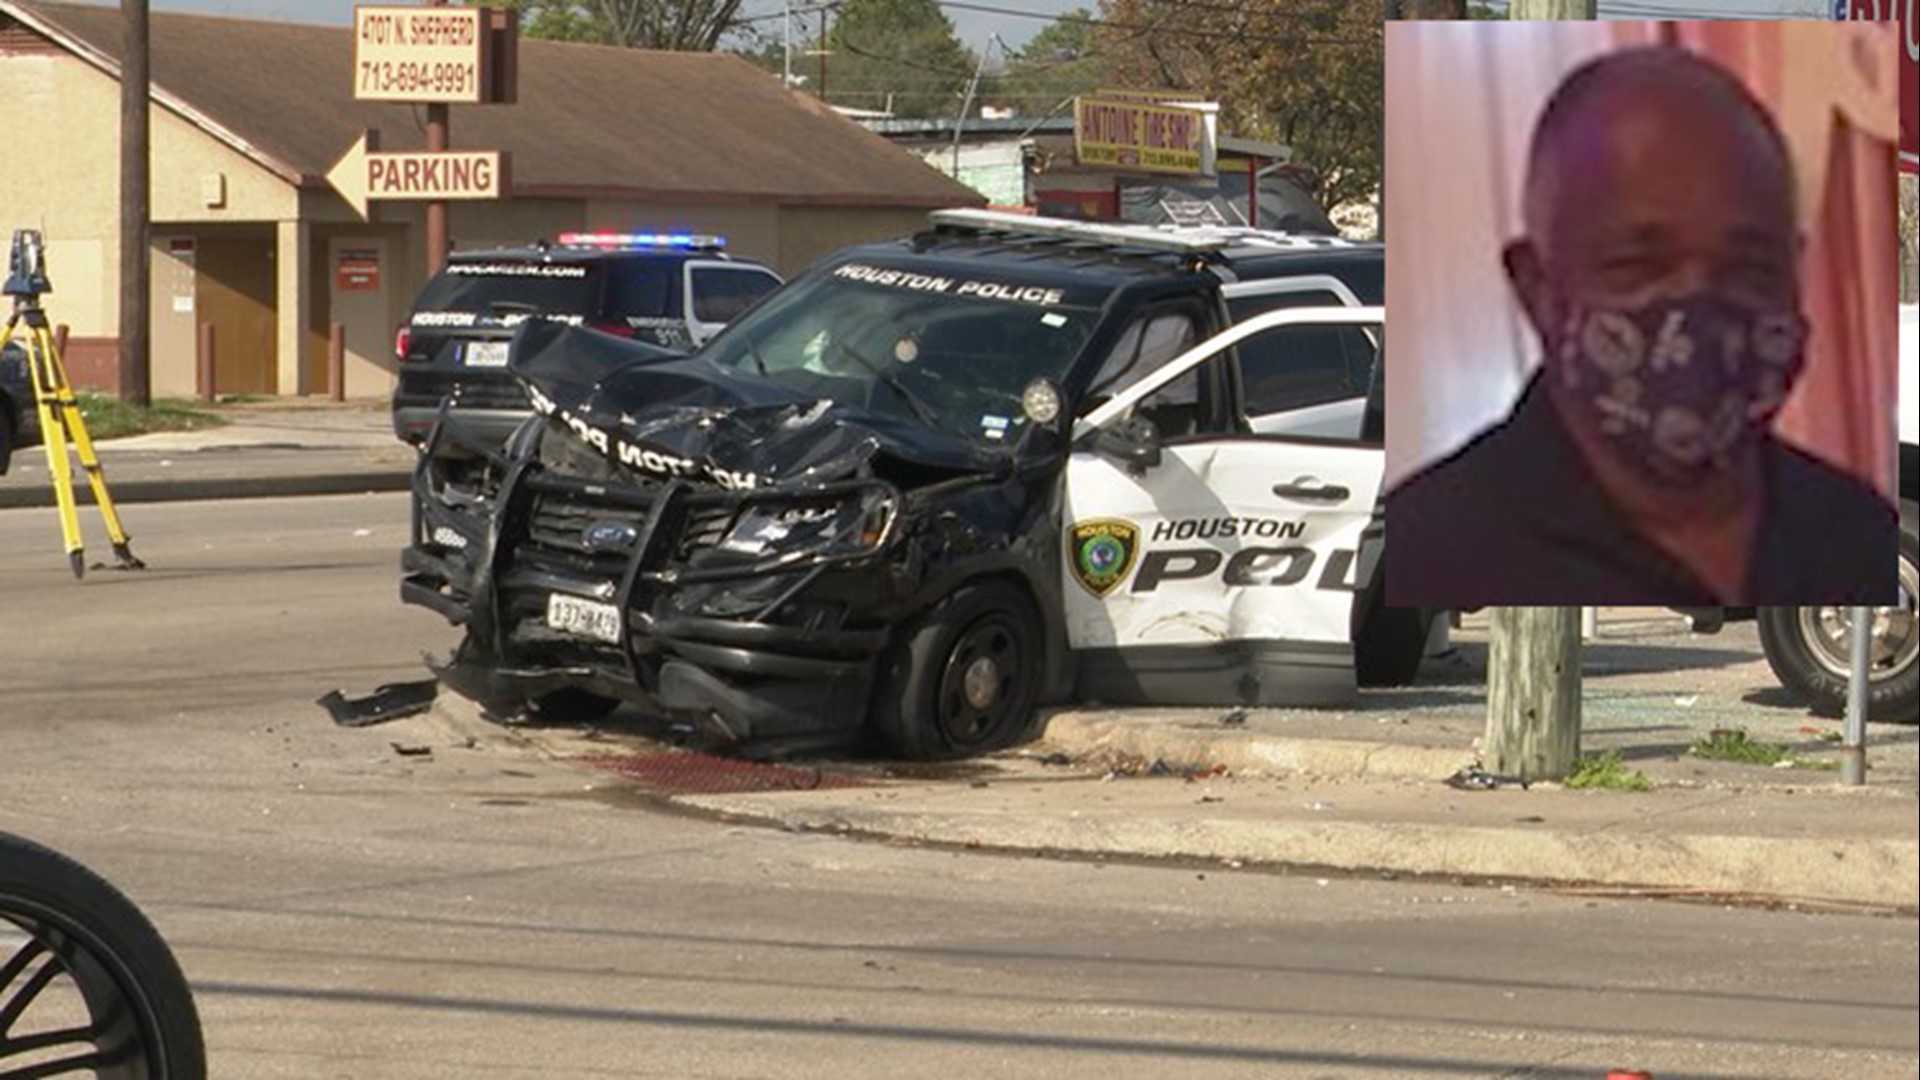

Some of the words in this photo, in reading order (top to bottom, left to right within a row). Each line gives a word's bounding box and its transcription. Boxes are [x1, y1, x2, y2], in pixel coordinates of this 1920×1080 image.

[361, 15, 391, 44] 4707
[411, 15, 474, 46] SHEPHERD
[361, 62, 475, 93] 713-694-9991
[1081, 104, 1138, 146] ANTOINE
[1143, 110, 1168, 149] TIRE
[368, 157, 492, 193] PARKING
[834, 263, 954, 293] HOUSTON
[957, 280, 1065, 306] POLICE
[412, 312, 477, 327] HOUSTON
[1151, 517, 1306, 542] HOUSTON
